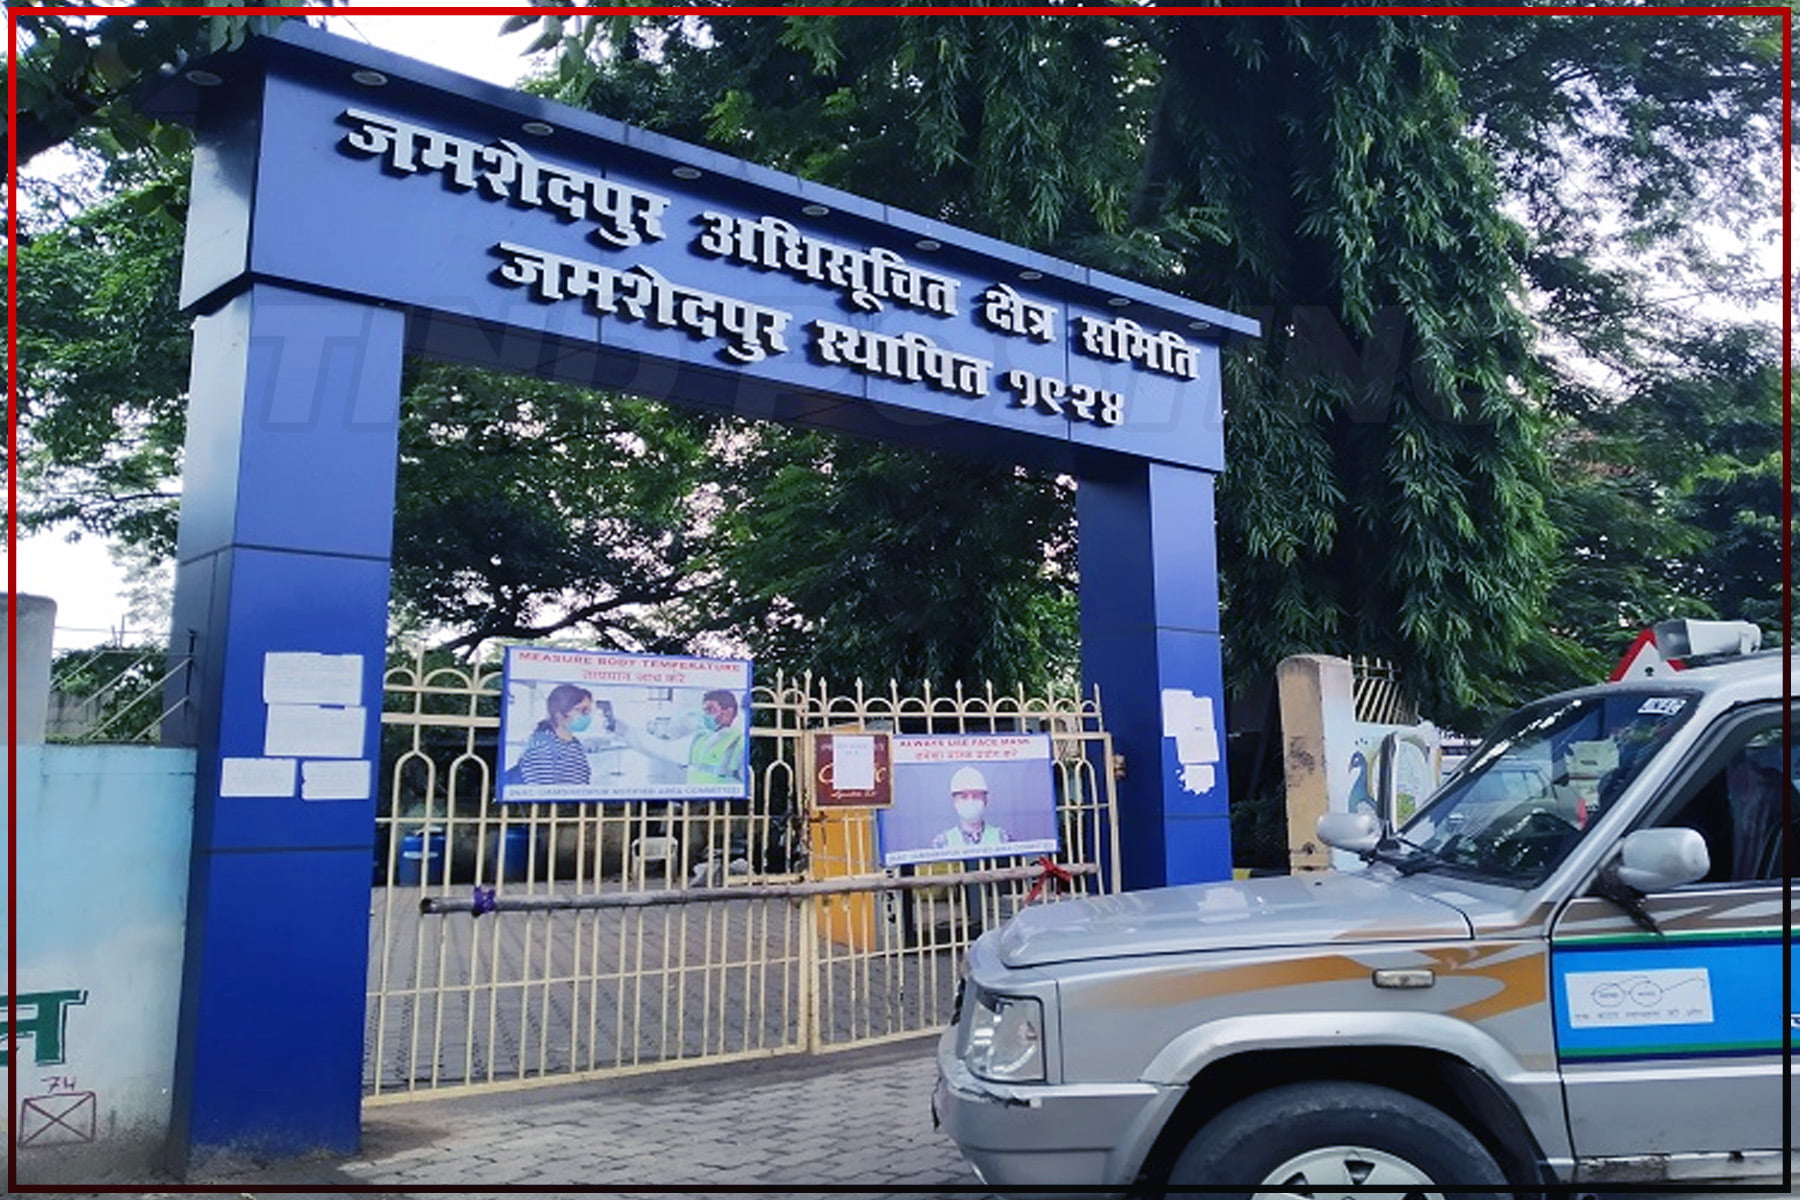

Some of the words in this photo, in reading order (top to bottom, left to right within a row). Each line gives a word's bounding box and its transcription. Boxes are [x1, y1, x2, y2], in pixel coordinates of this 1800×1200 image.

[346, 108, 671, 247] जमशेदपुर
[701, 209, 961, 316] अधिसूचित
[982, 284, 1058, 342] क्षेत्र
[1080, 315, 1200, 380] समिति
[498, 242, 793, 362] जमशेदपुर
[816, 318, 994, 396] स्थापित
[1009, 369, 1125, 426] १९२४
[518, 652, 592, 665] MEASURE
[598, 657, 636, 666] BODY
[643, 660, 741, 673] TEMPERATURE
[900, 739, 944, 748] ALWAYS
[948, 739, 967, 747] USE
[972, 738, 997, 747] FACE
[1000, 738, 1030, 746] MASK
